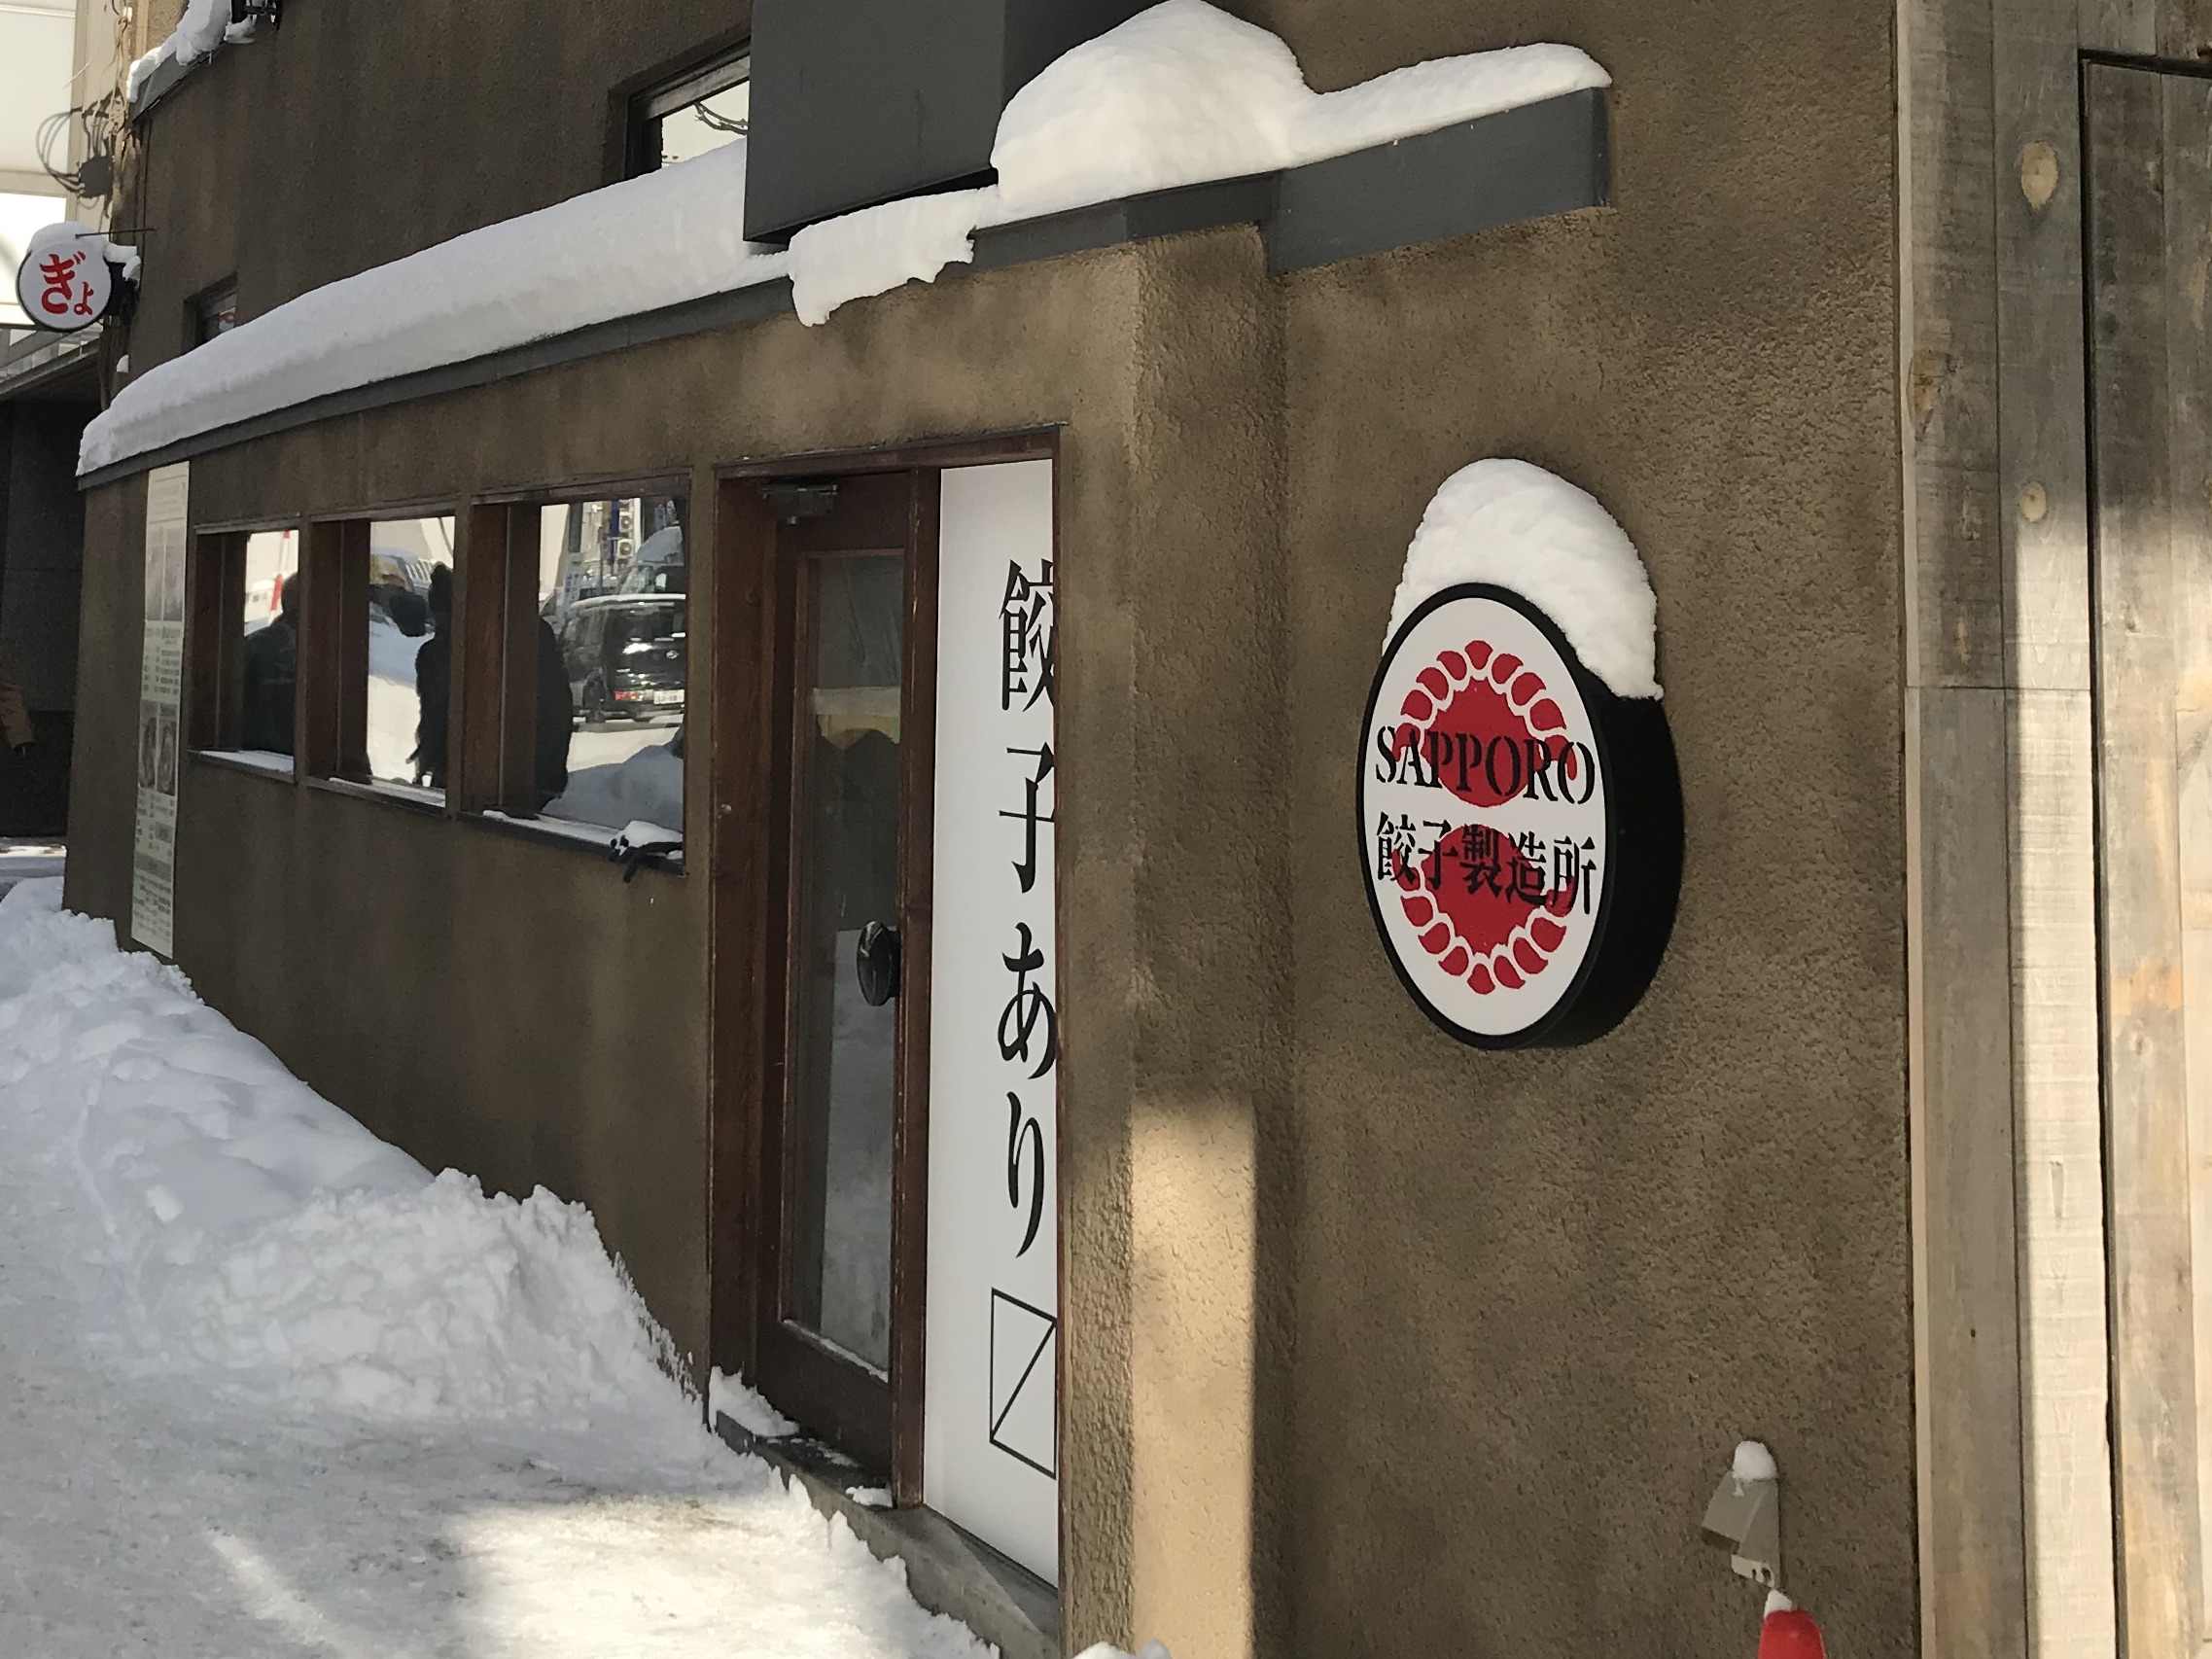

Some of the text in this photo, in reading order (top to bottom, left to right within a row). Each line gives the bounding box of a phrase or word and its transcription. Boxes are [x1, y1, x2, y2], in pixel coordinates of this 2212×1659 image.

[40, 250, 94, 315] ぎょ
[1376, 725, 1596, 805] SAPPORO
[999, 558, 1057, 1258] 餃子あり
[1376, 811, 1598, 915] 餃子製造所
